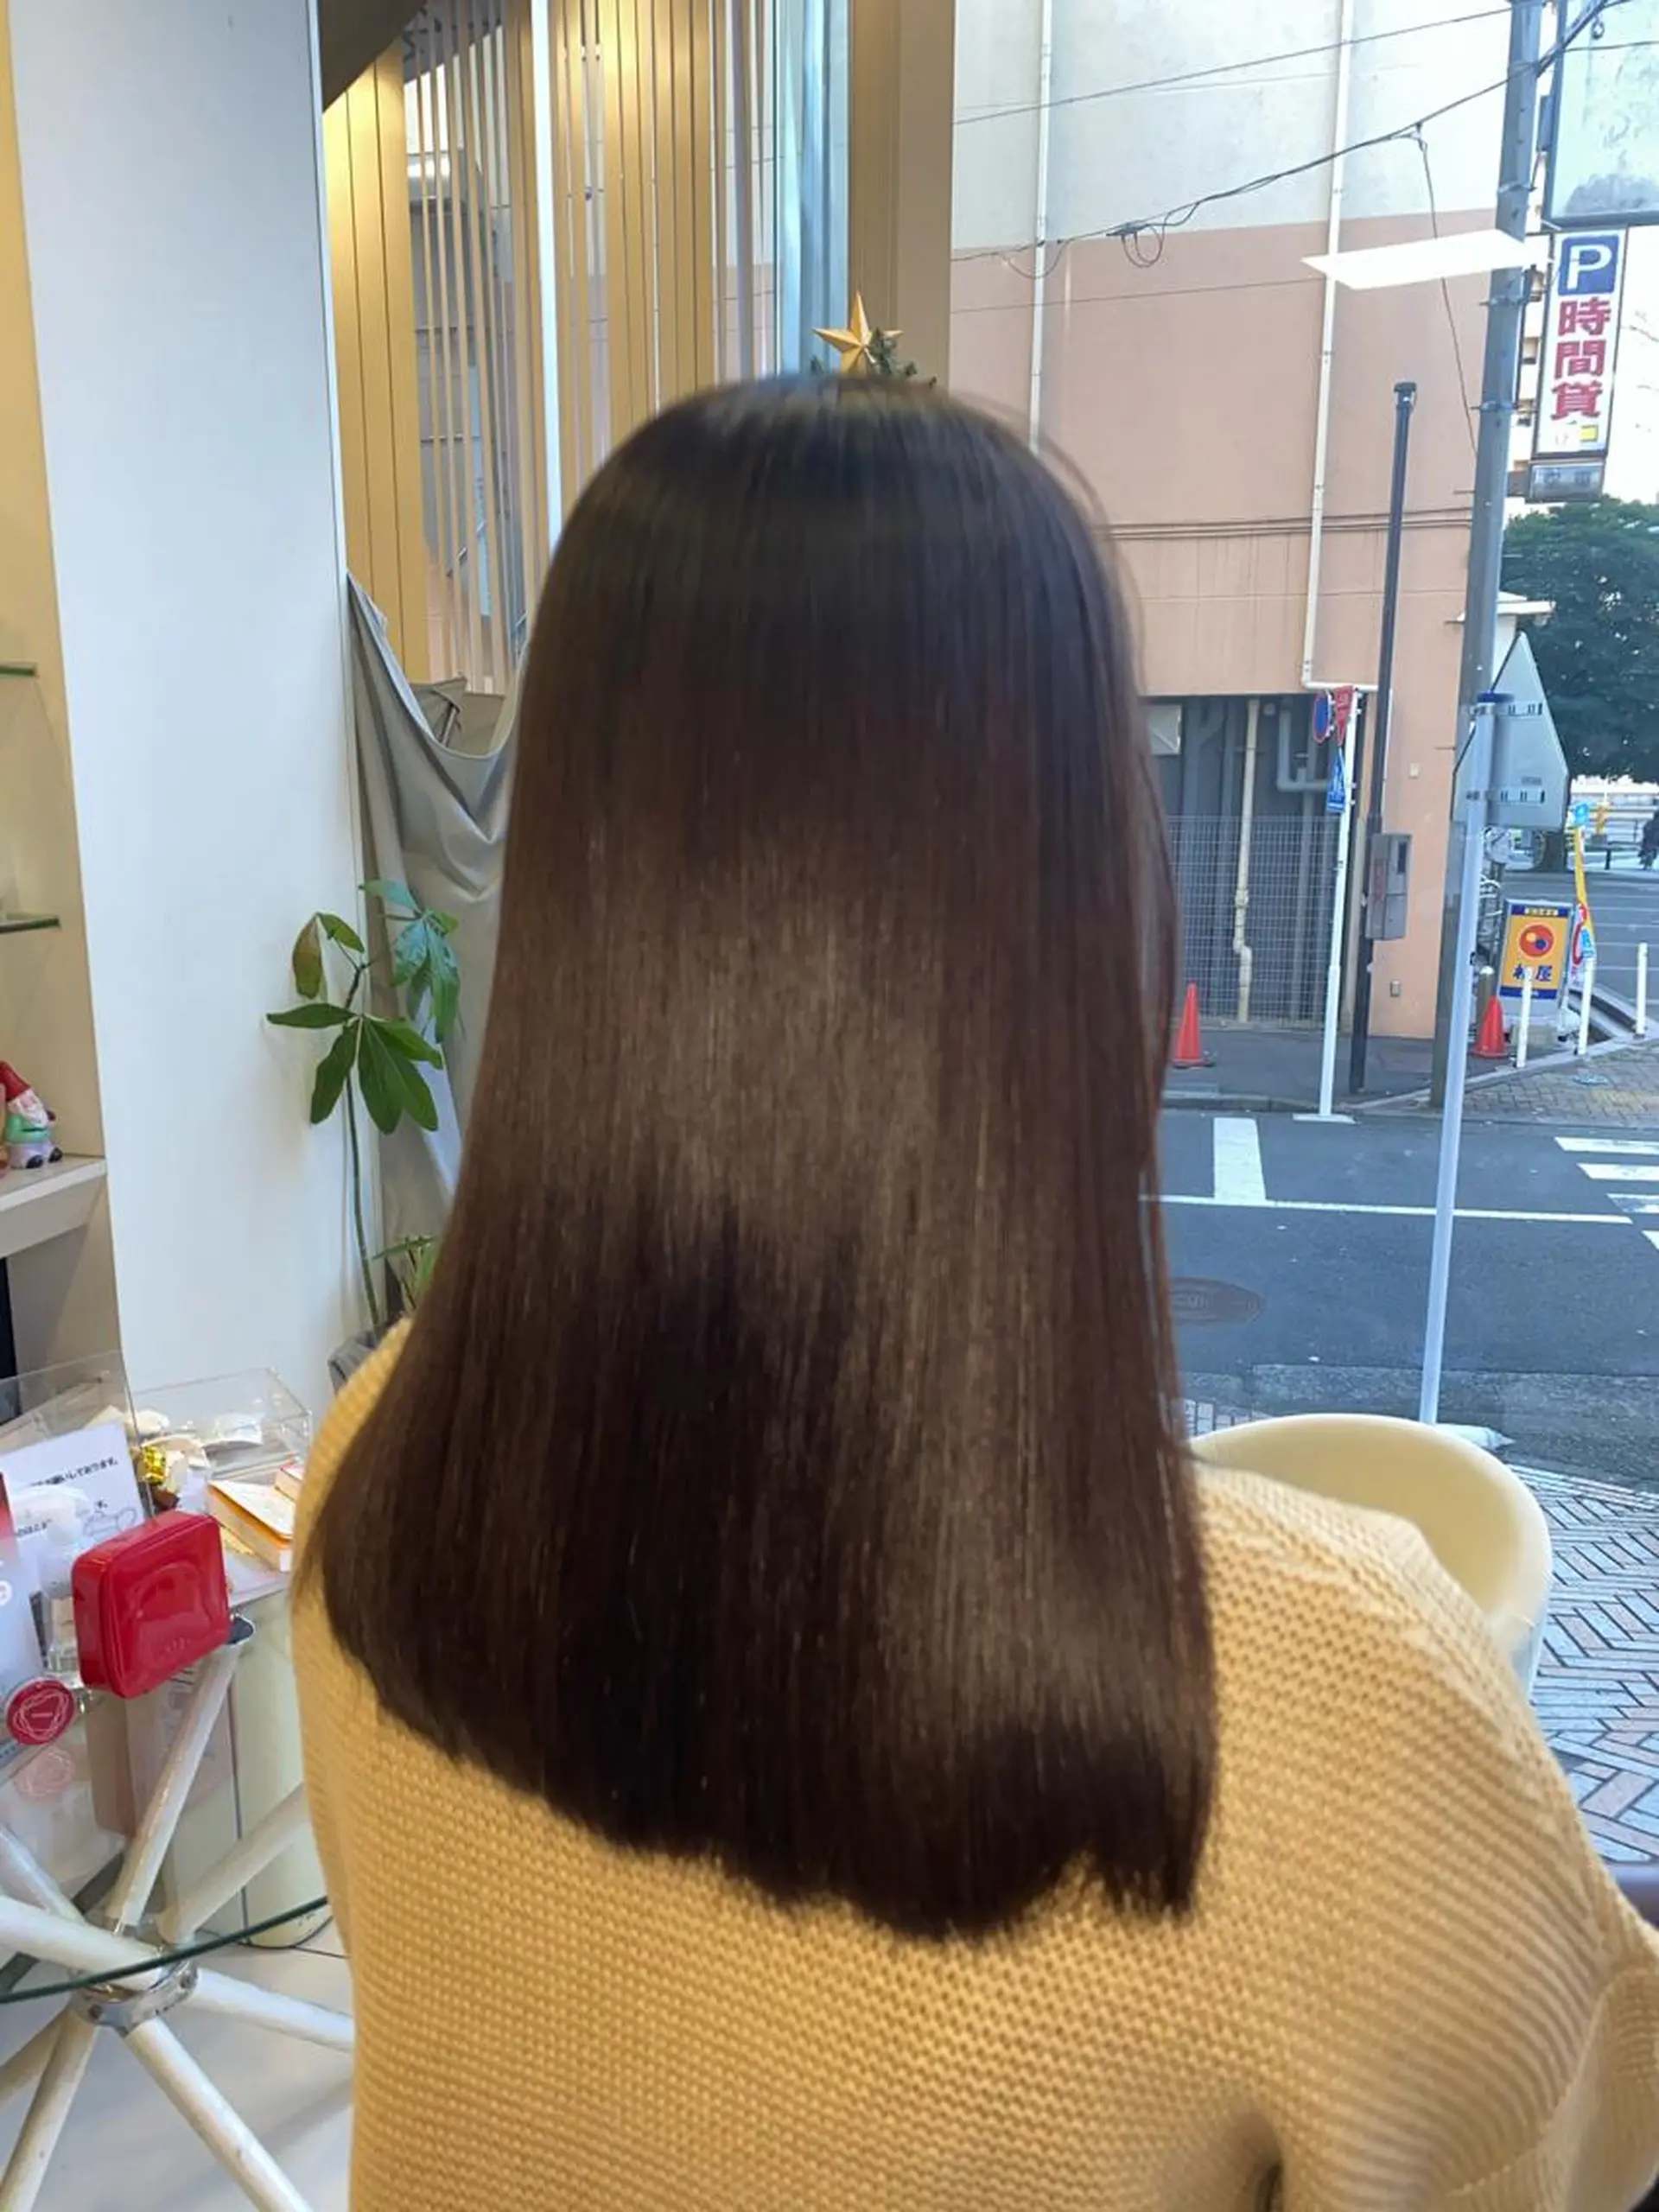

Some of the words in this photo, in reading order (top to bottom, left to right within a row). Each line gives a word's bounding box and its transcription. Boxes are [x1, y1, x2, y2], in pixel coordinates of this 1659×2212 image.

[1567, 245, 1612, 290] P
[1550, 296, 1611, 421] 時間貸
